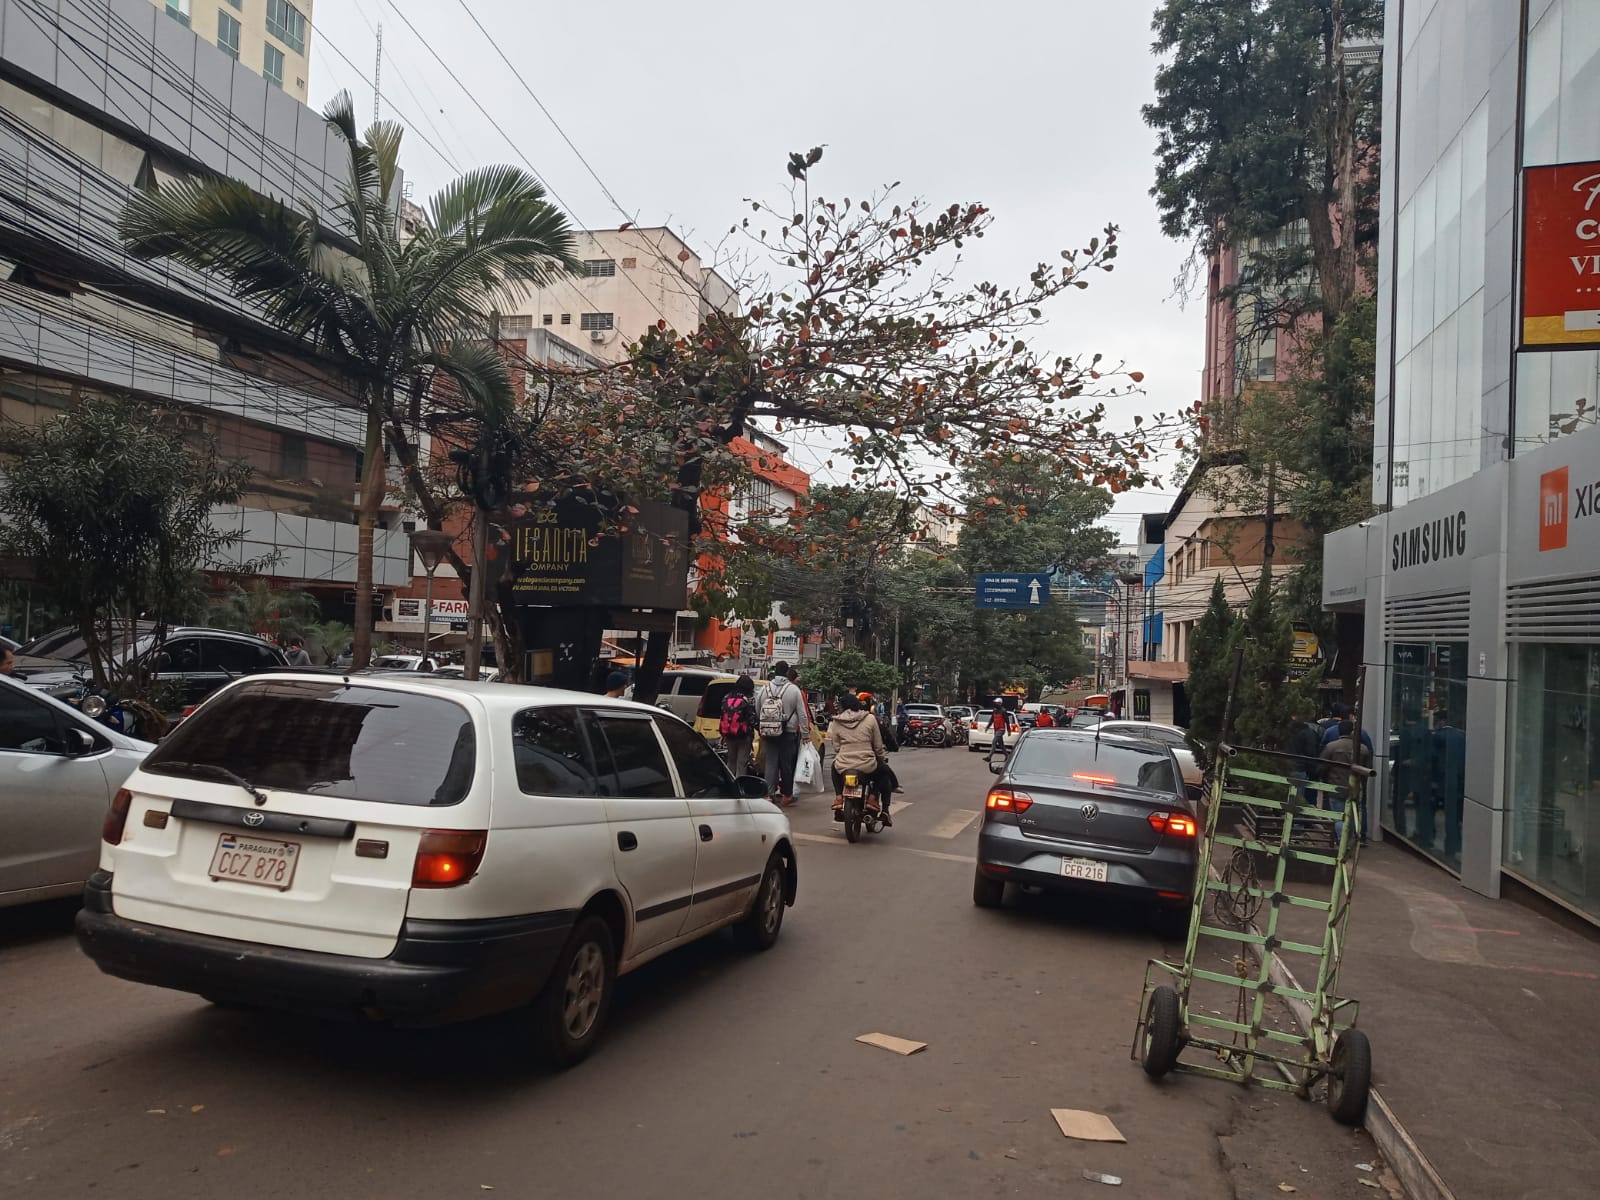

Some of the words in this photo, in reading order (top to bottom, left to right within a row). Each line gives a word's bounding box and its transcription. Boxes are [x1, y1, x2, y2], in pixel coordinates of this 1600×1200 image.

[1392, 510, 1466, 571] SAMSUNG
[525, 563, 569, 571] OMPANY
[238, 843, 277, 855] PARAGUAY
[218, 851, 252, 877] CCZ
[254, 857, 287, 881] 878
[1064, 863, 1083, 876] CFR
[1085, 866, 1104, 880] 216
